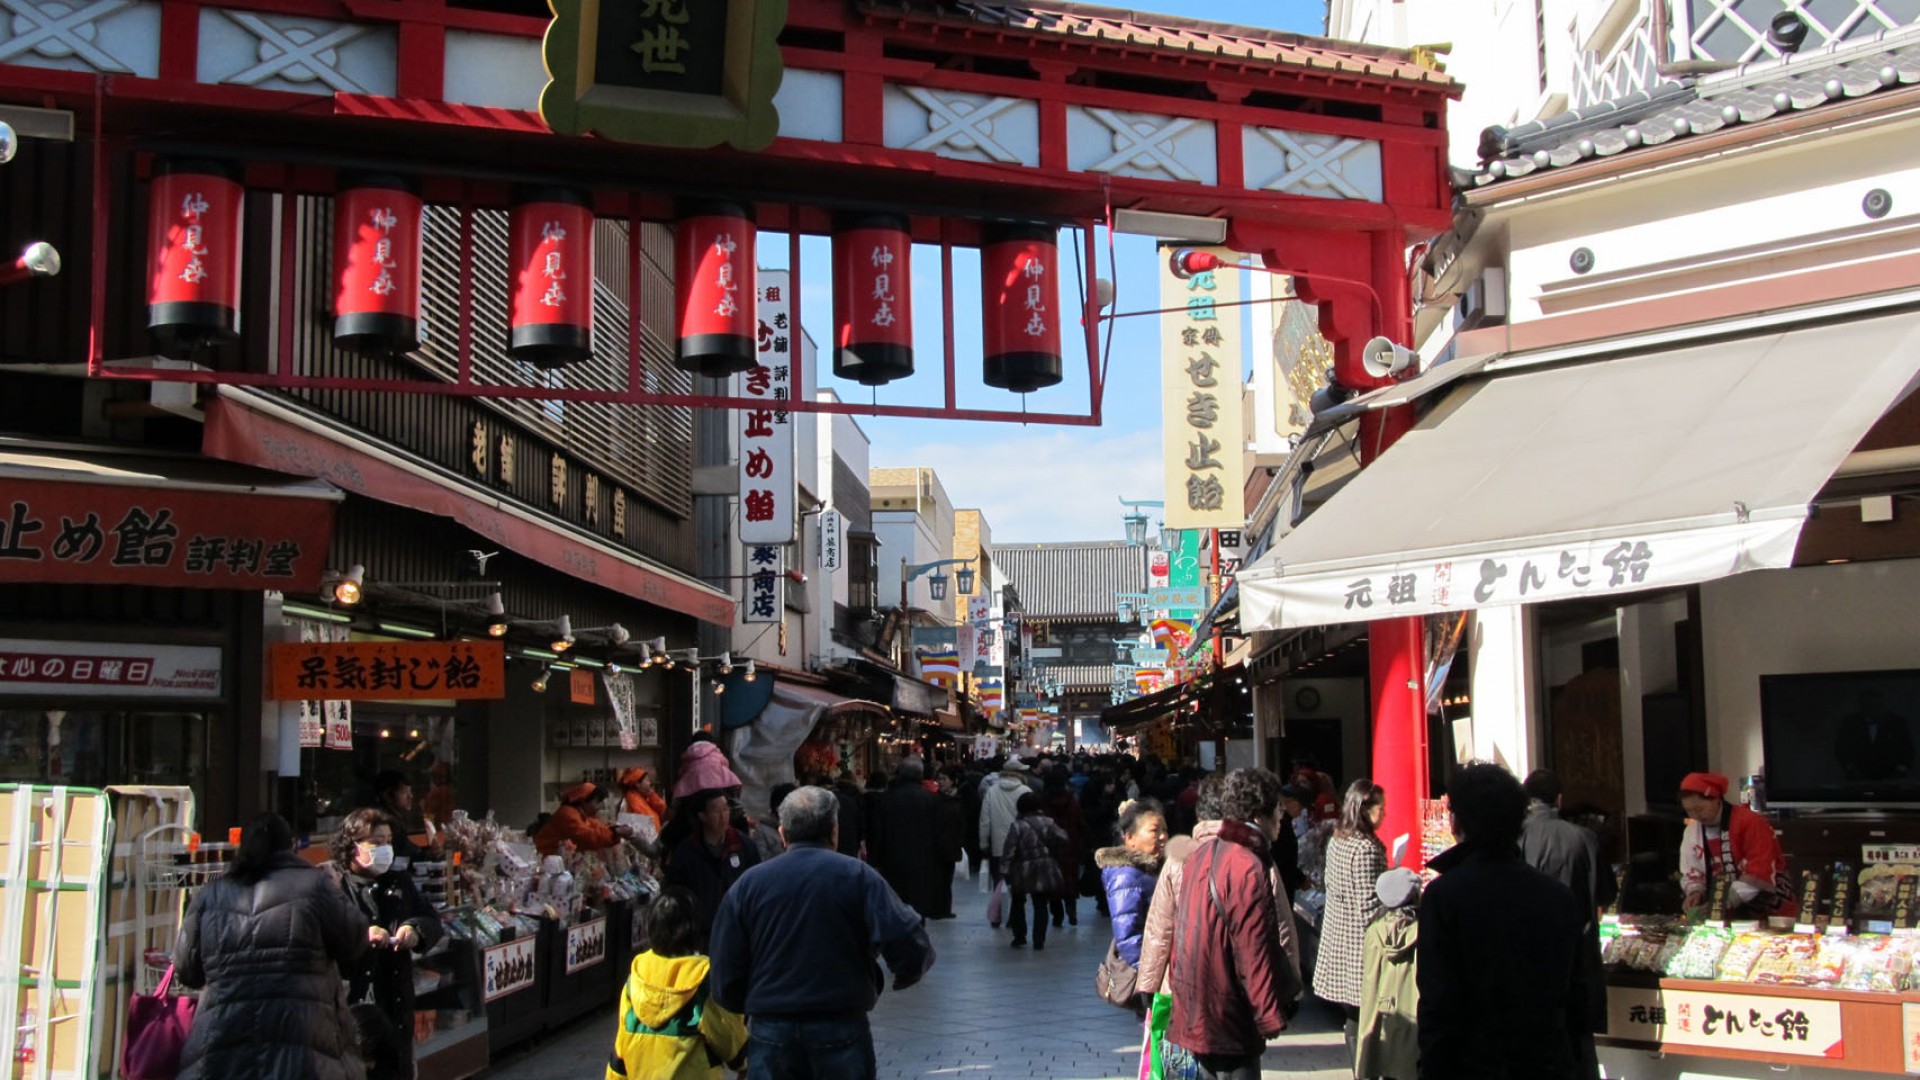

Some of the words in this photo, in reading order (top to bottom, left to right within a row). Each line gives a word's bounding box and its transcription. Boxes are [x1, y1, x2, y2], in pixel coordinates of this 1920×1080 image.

[178, 193, 209, 284] 仲見世
[368, 207, 397, 297] 仲見世
[540, 221, 568, 307] 仲見世
[713, 233, 739, 318] 仲見世
[757, 286, 781, 302] 祖
[870, 245, 896, 328] 仲見世
[1022, 257, 1047, 337] 仲見世
[1185, 351, 1225, 511] せき止飴
[0, 502, 178, 566] 止め飴
[185, 536, 300, 576] 評判堂
[1344, 573, 1417, 610] 元祖
[1431, 562, 1453, 608] 開運
[1473, 541, 1653, 604] とんとこ飴
[297, 654, 481, 691] 呆気封じ飴
[1629, 1004, 1669, 1026] 元祖
[1702, 1003, 1810, 1041] とんとこ飴
